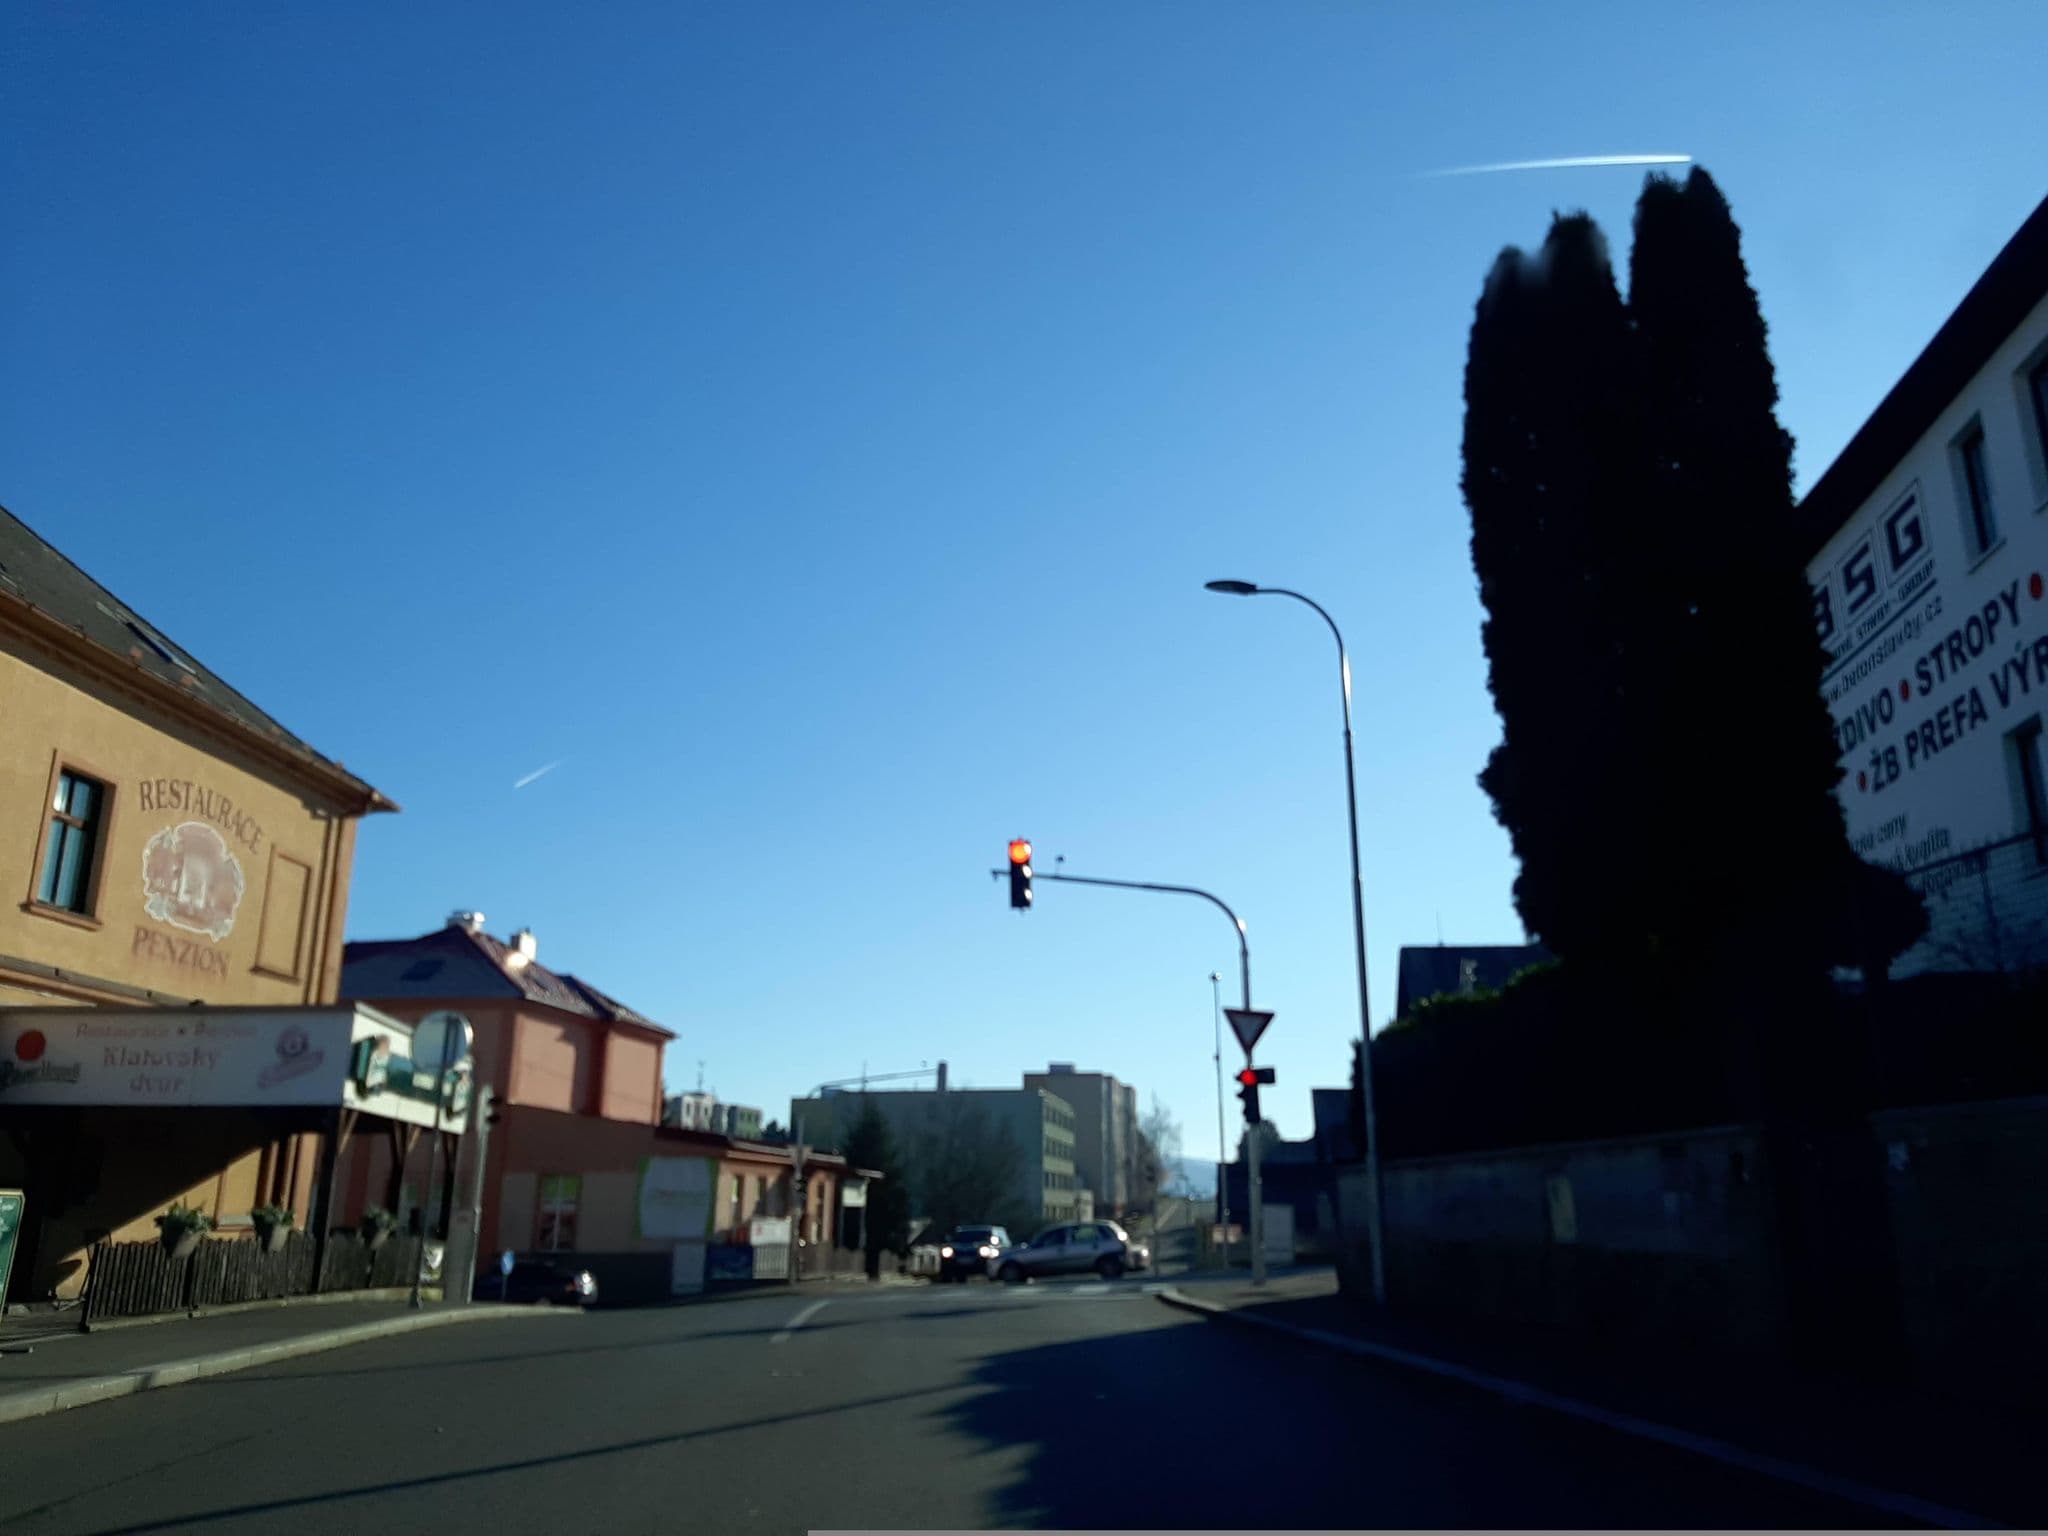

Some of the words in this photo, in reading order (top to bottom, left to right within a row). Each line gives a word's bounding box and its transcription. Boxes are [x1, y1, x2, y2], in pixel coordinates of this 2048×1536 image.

[1914, 578, 2020, 698] STROPY
[1869, 746, 1902, 794] ŽB
[1904, 686, 1989, 771] PREFA
[139, 777, 265, 855] RESTAURACE
[132, 925, 231, 979] PENZION
